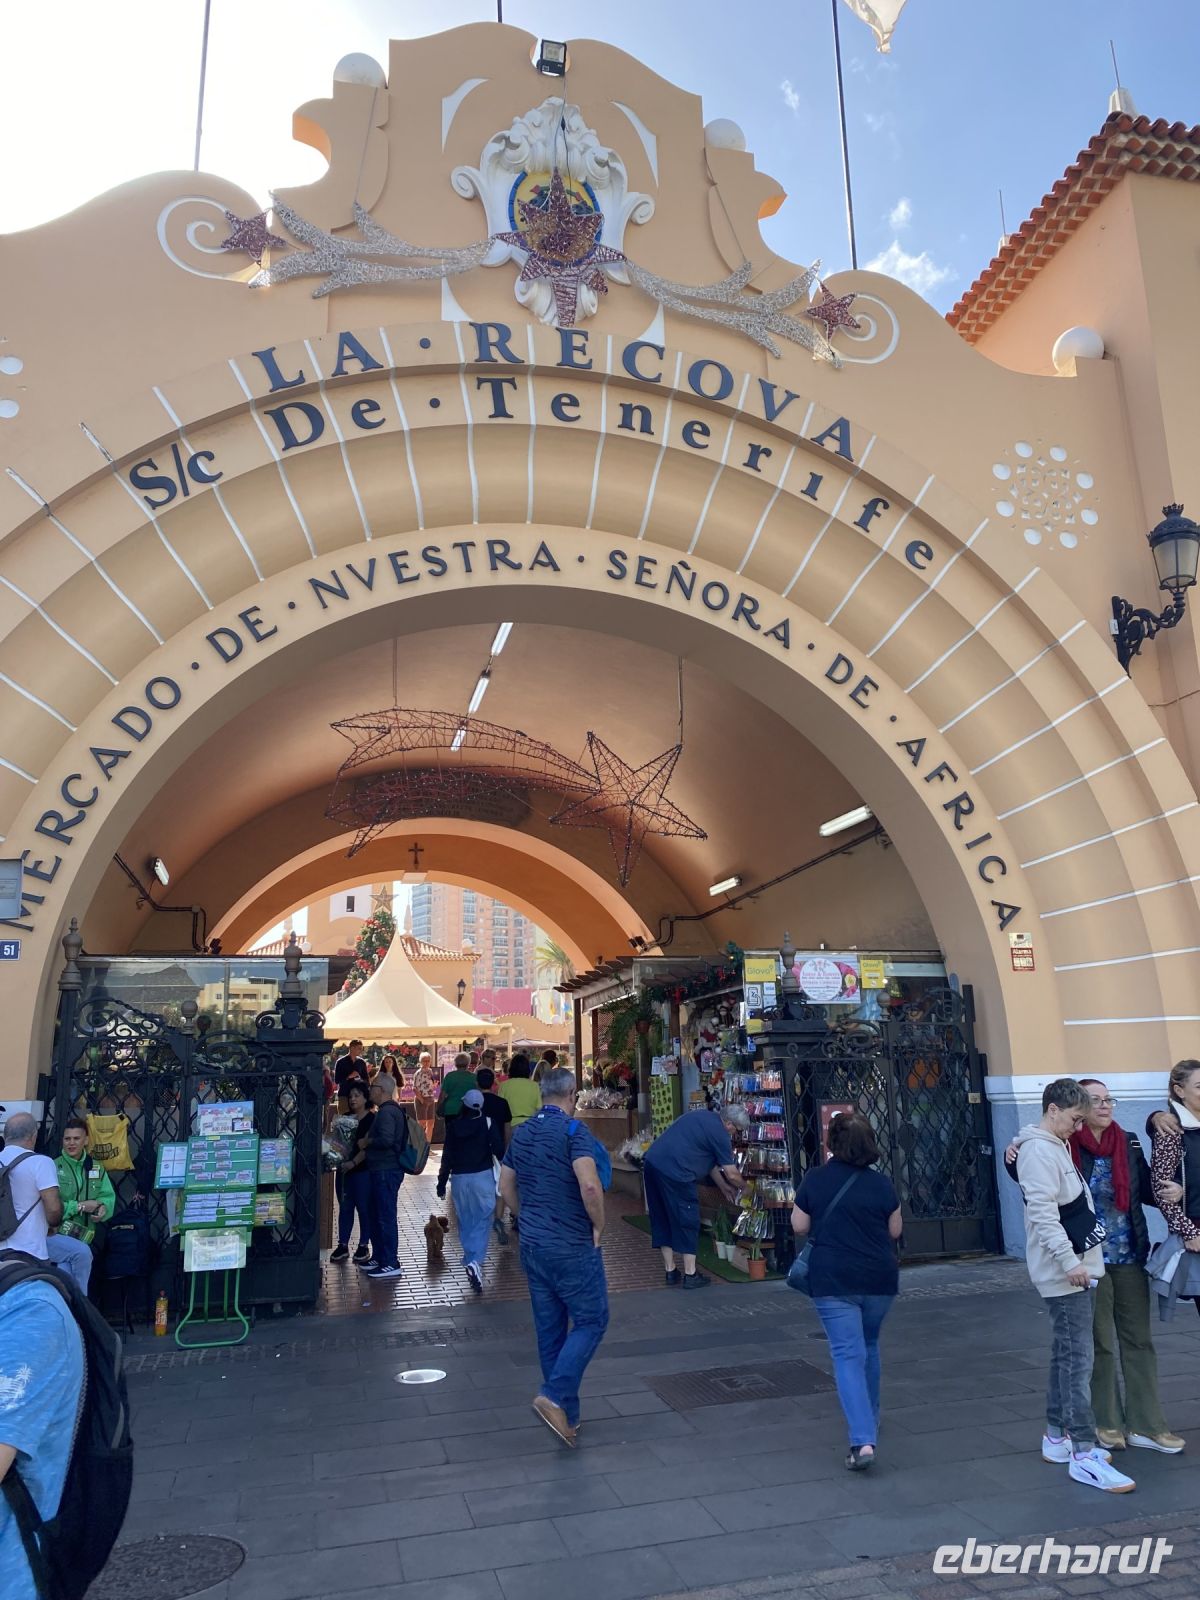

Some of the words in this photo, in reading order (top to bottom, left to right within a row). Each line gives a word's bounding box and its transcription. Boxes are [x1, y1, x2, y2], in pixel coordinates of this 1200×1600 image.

[129, 443, 223, 510] S/c
[264, 398, 386, 451] De
[476, 377, 933, 570] Tenerife
[251, 331, 383, 393] LA
[469, 321, 854, 461] RECOVA
[206, 605, 278, 664] DE
[308, 539, 561, 609] NVESTRA
[606, 550, 790, 649] SEÑORA
[825, 652, 879, 709] DE
[896, 737, 1022, 931] AFRICA
[3, 944, 15, 956] 51
